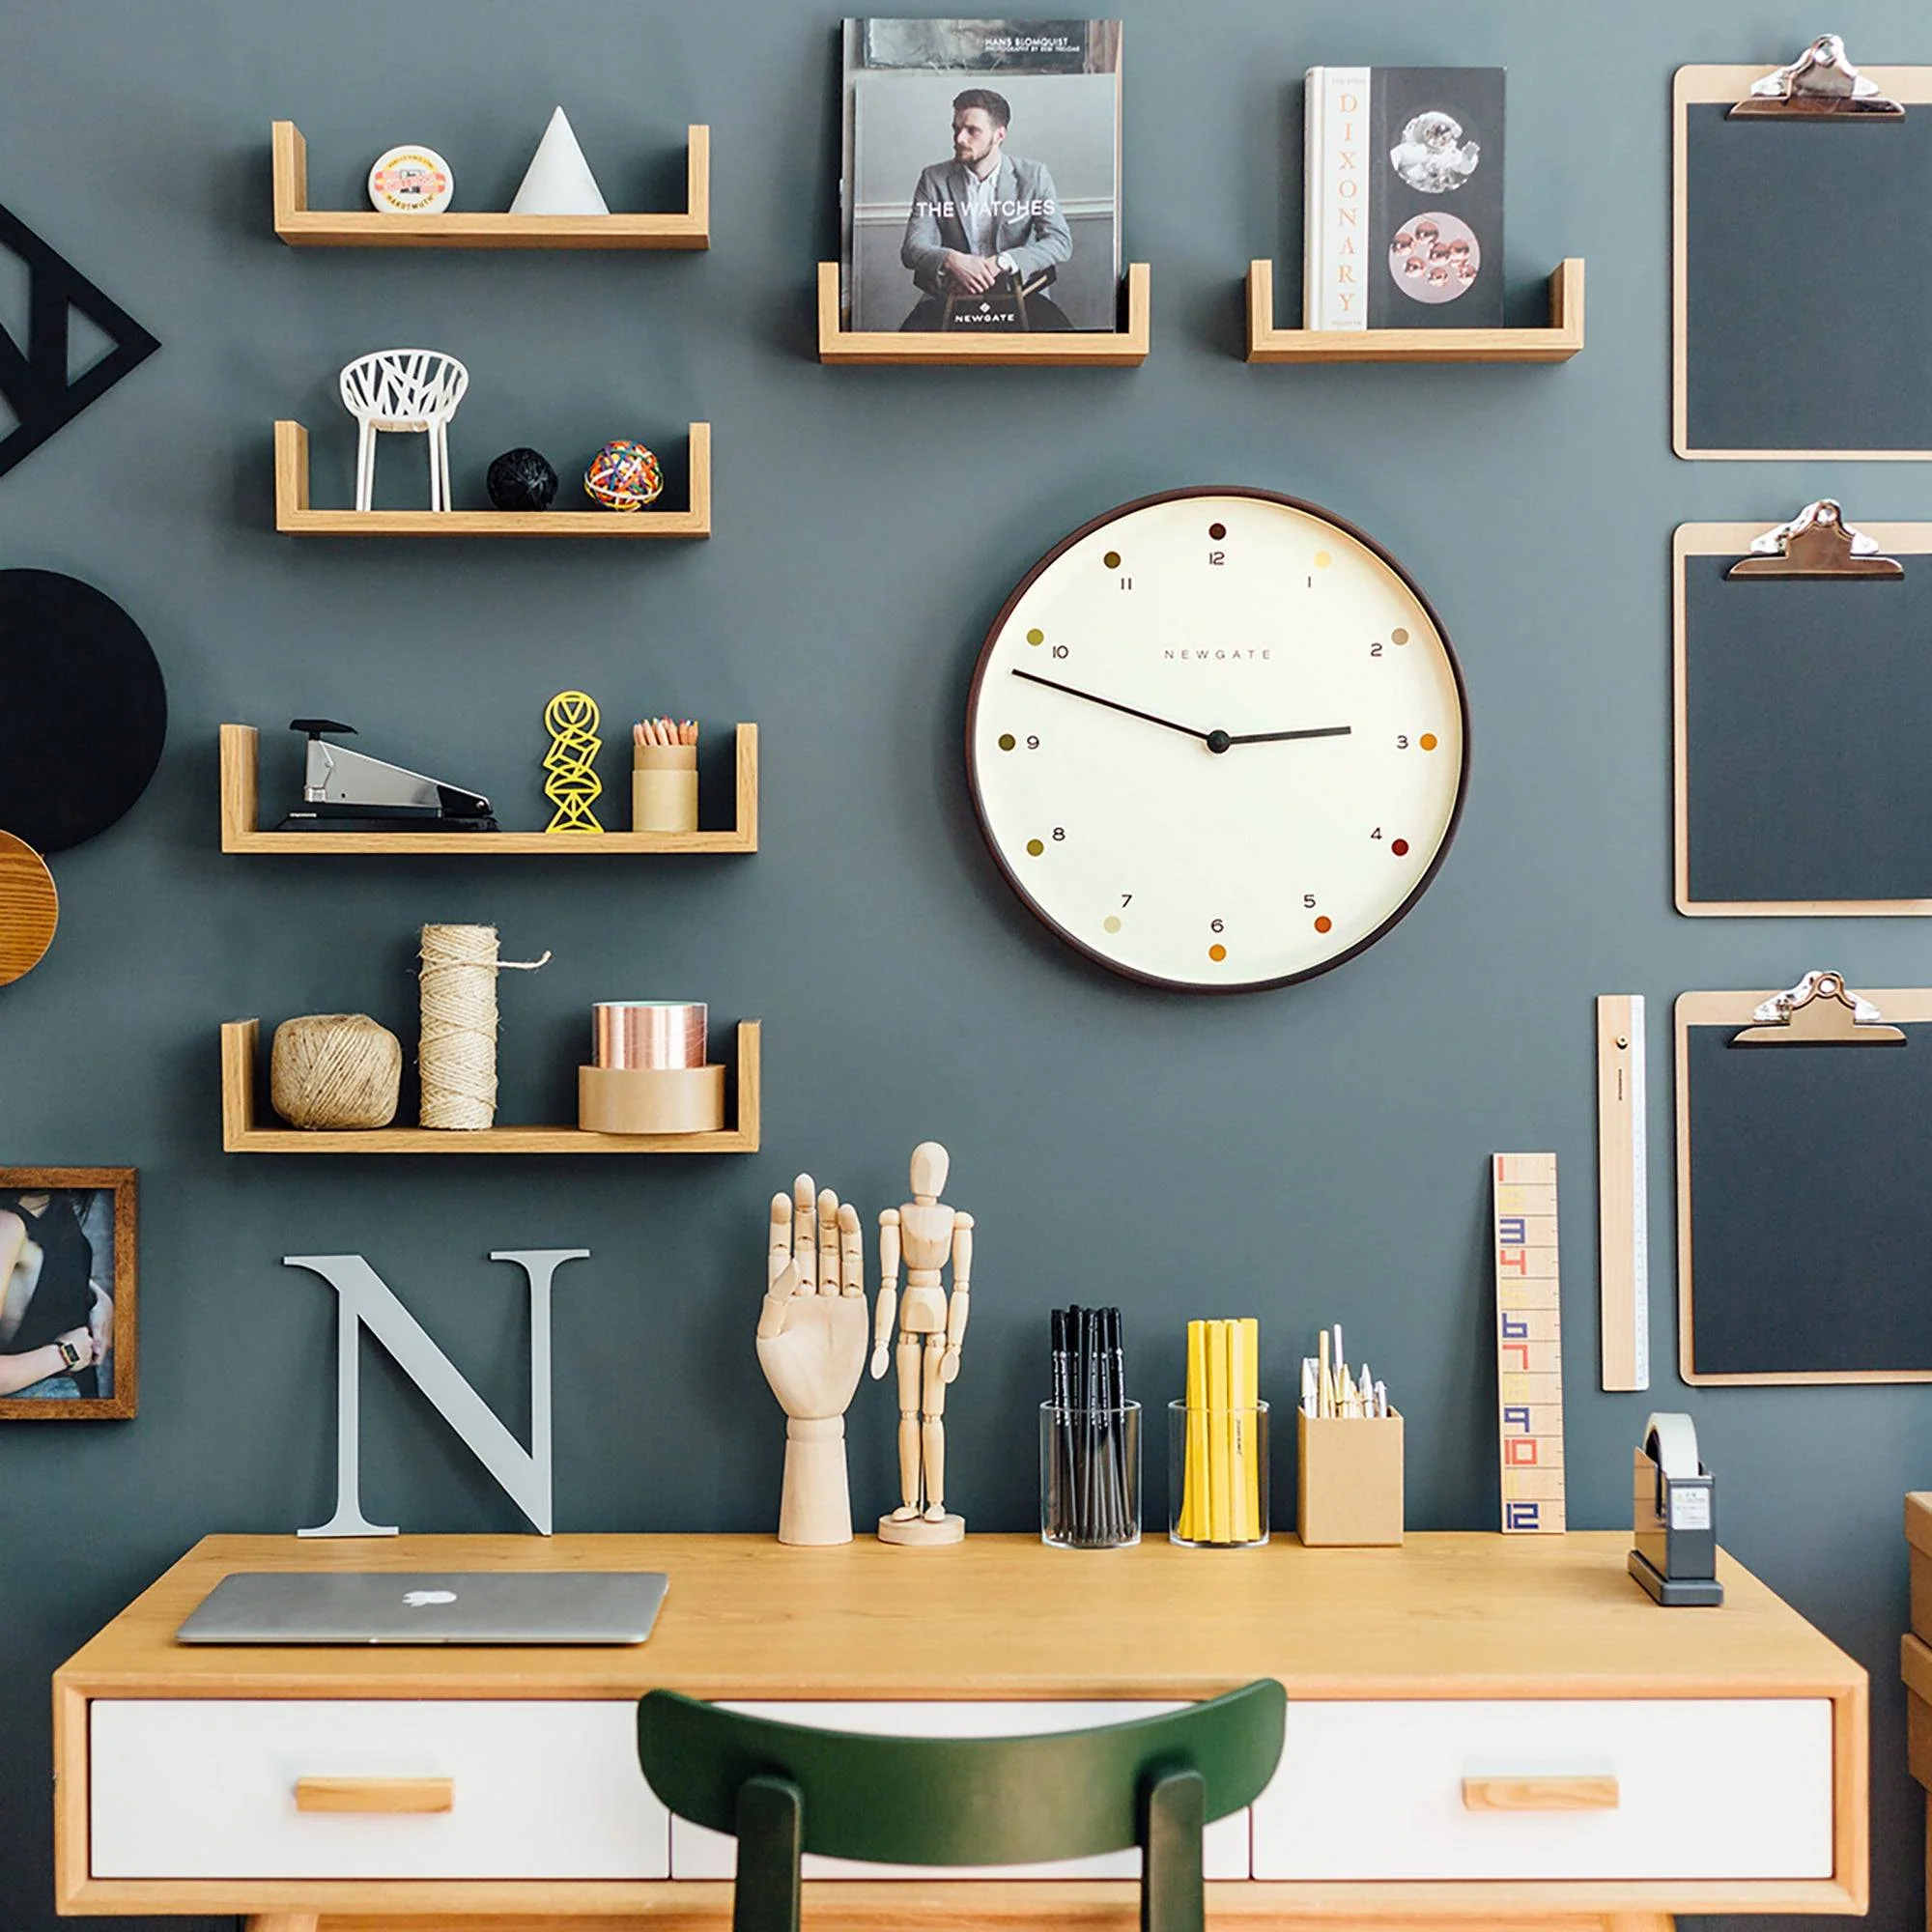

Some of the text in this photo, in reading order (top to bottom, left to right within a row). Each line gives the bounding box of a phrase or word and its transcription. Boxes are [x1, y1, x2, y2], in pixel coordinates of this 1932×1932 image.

[985, 37, 1068, 46] HANS BLOMQUIST
[916, 199, 1056, 218] THE WATCHES
[1338, 94, 1358, 312] DIXONARY
[954, 313, 1015, 323] NEWGATE
[1208, 551, 1226, 566] 12
[1120, 577, 1133, 591] 11
[1052, 644, 1069, 660] 10
[1164, 649, 1272, 660] NEWGATE
[1370, 642, 1383, 658] 2
[1026, 734, 1040, 751] 9
[1397, 734, 1409, 750] 3
[1051, 827, 1066, 842] 8
[1370, 827, 1382, 840] 4
[1121, 894, 1133, 908] 7
[1303, 894, 1317, 909] 5
[1210, 918, 1225, 934] 6
[1499, 1218, 1525, 1244] 3
[1499, 1250, 1526, 1275] 4
[1501, 1313, 1528, 1339] 6
[1502, 1344, 1529, 1370] 7
[283, 1249, 590, 1537] N
[1504, 1406, 1530, 1434] 9
[1504, 1438, 1538, 1465] 10
[1506, 1503, 1540, 1530] 12
